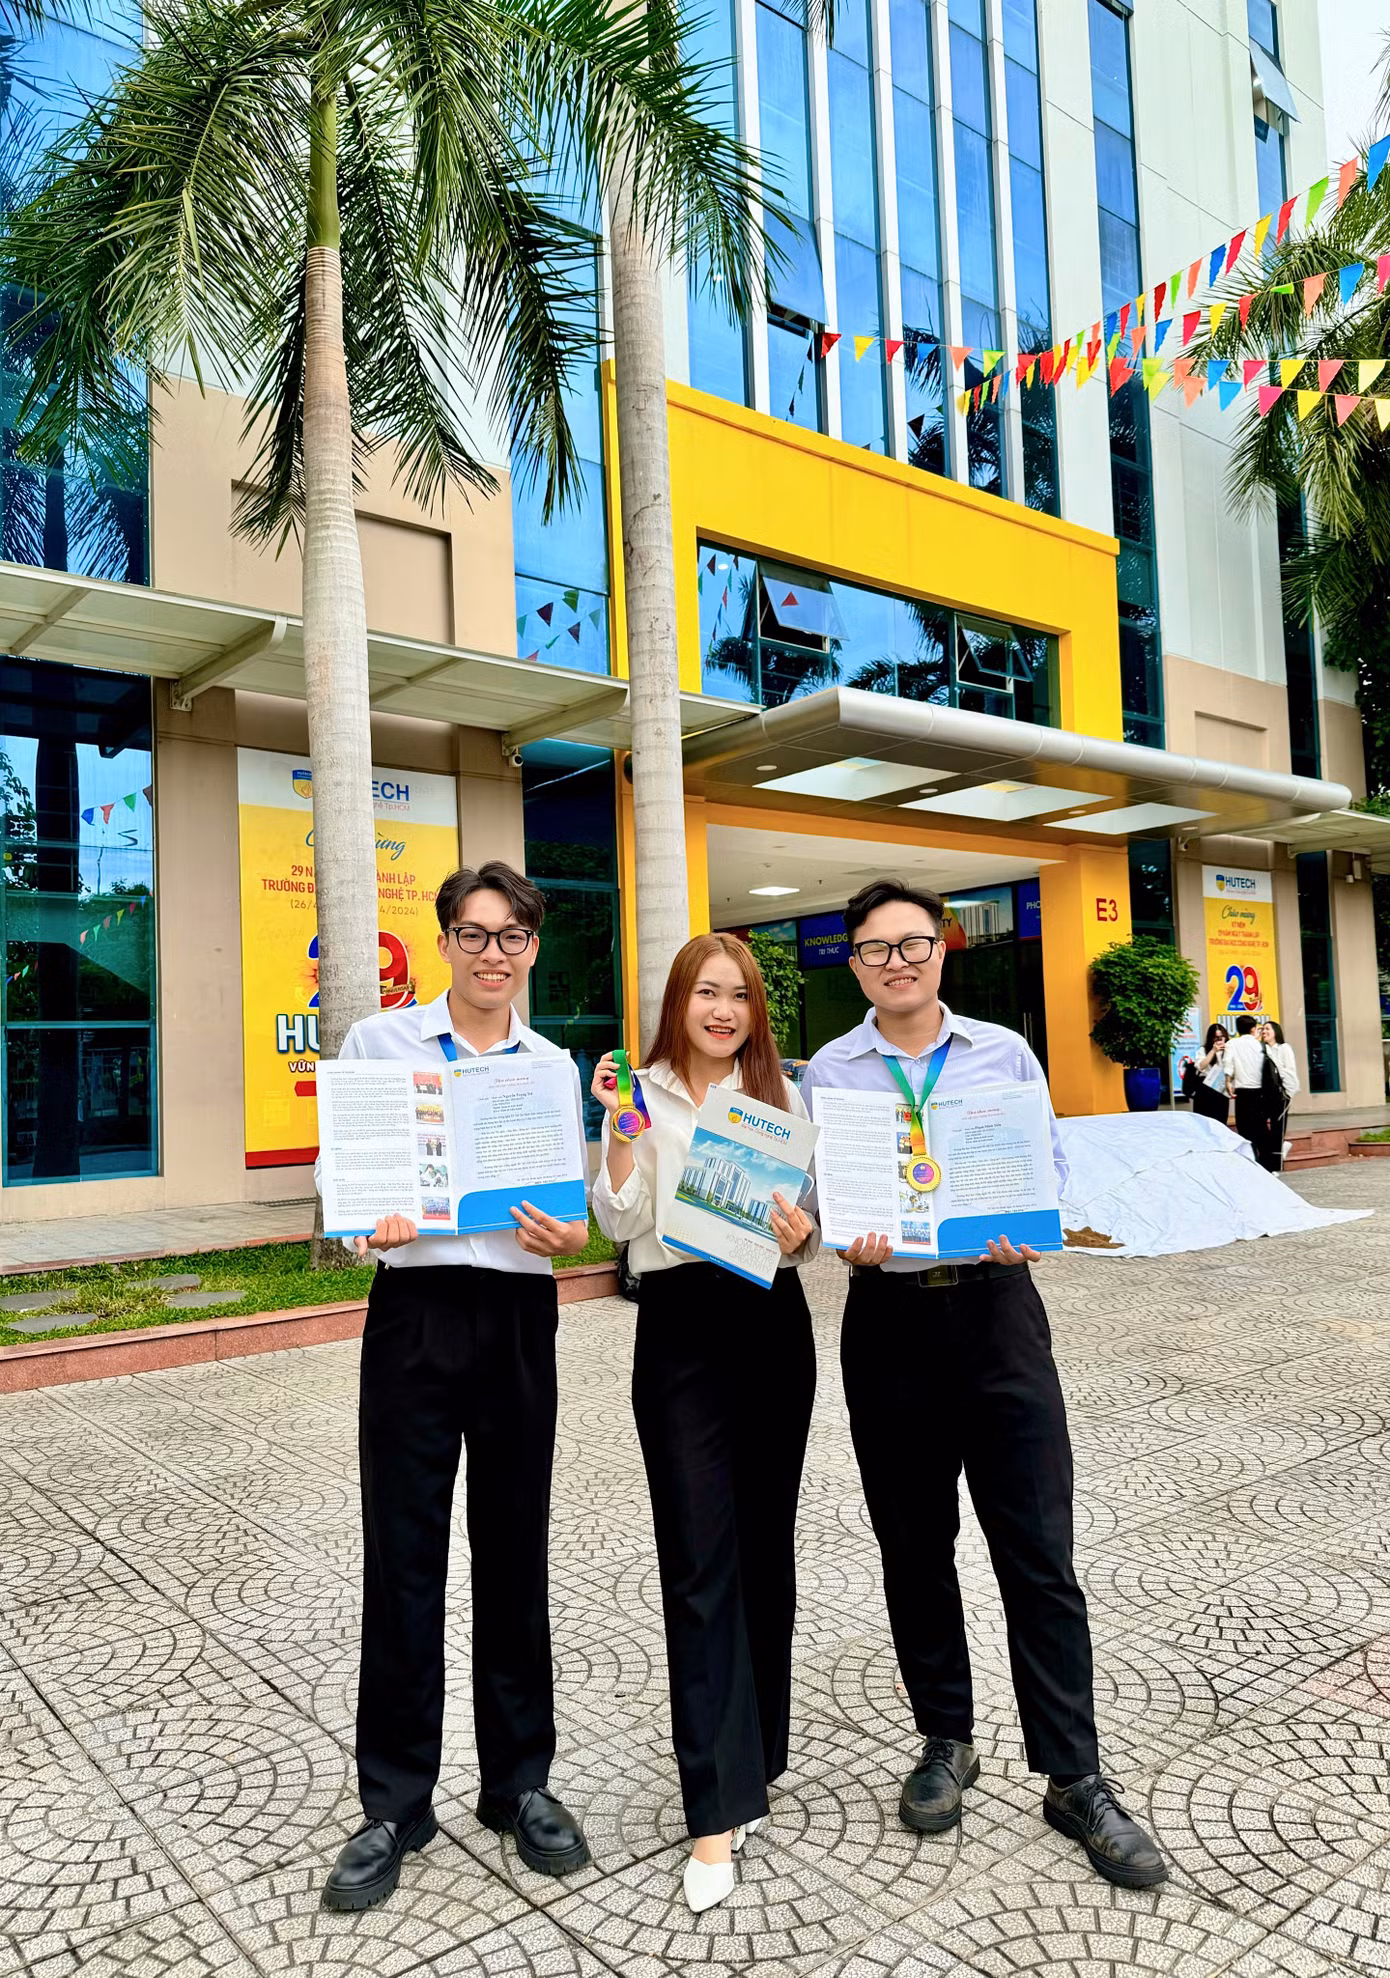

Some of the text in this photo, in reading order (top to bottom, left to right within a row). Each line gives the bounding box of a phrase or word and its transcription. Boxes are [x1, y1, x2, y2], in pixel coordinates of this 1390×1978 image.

[372, 781, 409, 801] ECH
[291, 865, 303, 876] 29
[262, 878, 305, 893] TRƯỜNG
[1225, 876, 1256, 889] HUTECH
[378, 887, 404, 902] NGHỆ
[1026, 901, 1040, 910] PHO
[1096, 898, 1118, 921] E3
[804, 933, 848, 946] KNOWLEDG
[1226, 965, 1259, 1011] 29
[288, 1059, 315, 1073] VỮN
[462, 1066, 489, 1074] HUTECH
[939, 1099, 963, 1107] HUTECH
[743, 1113, 791, 1140] HUTECH
